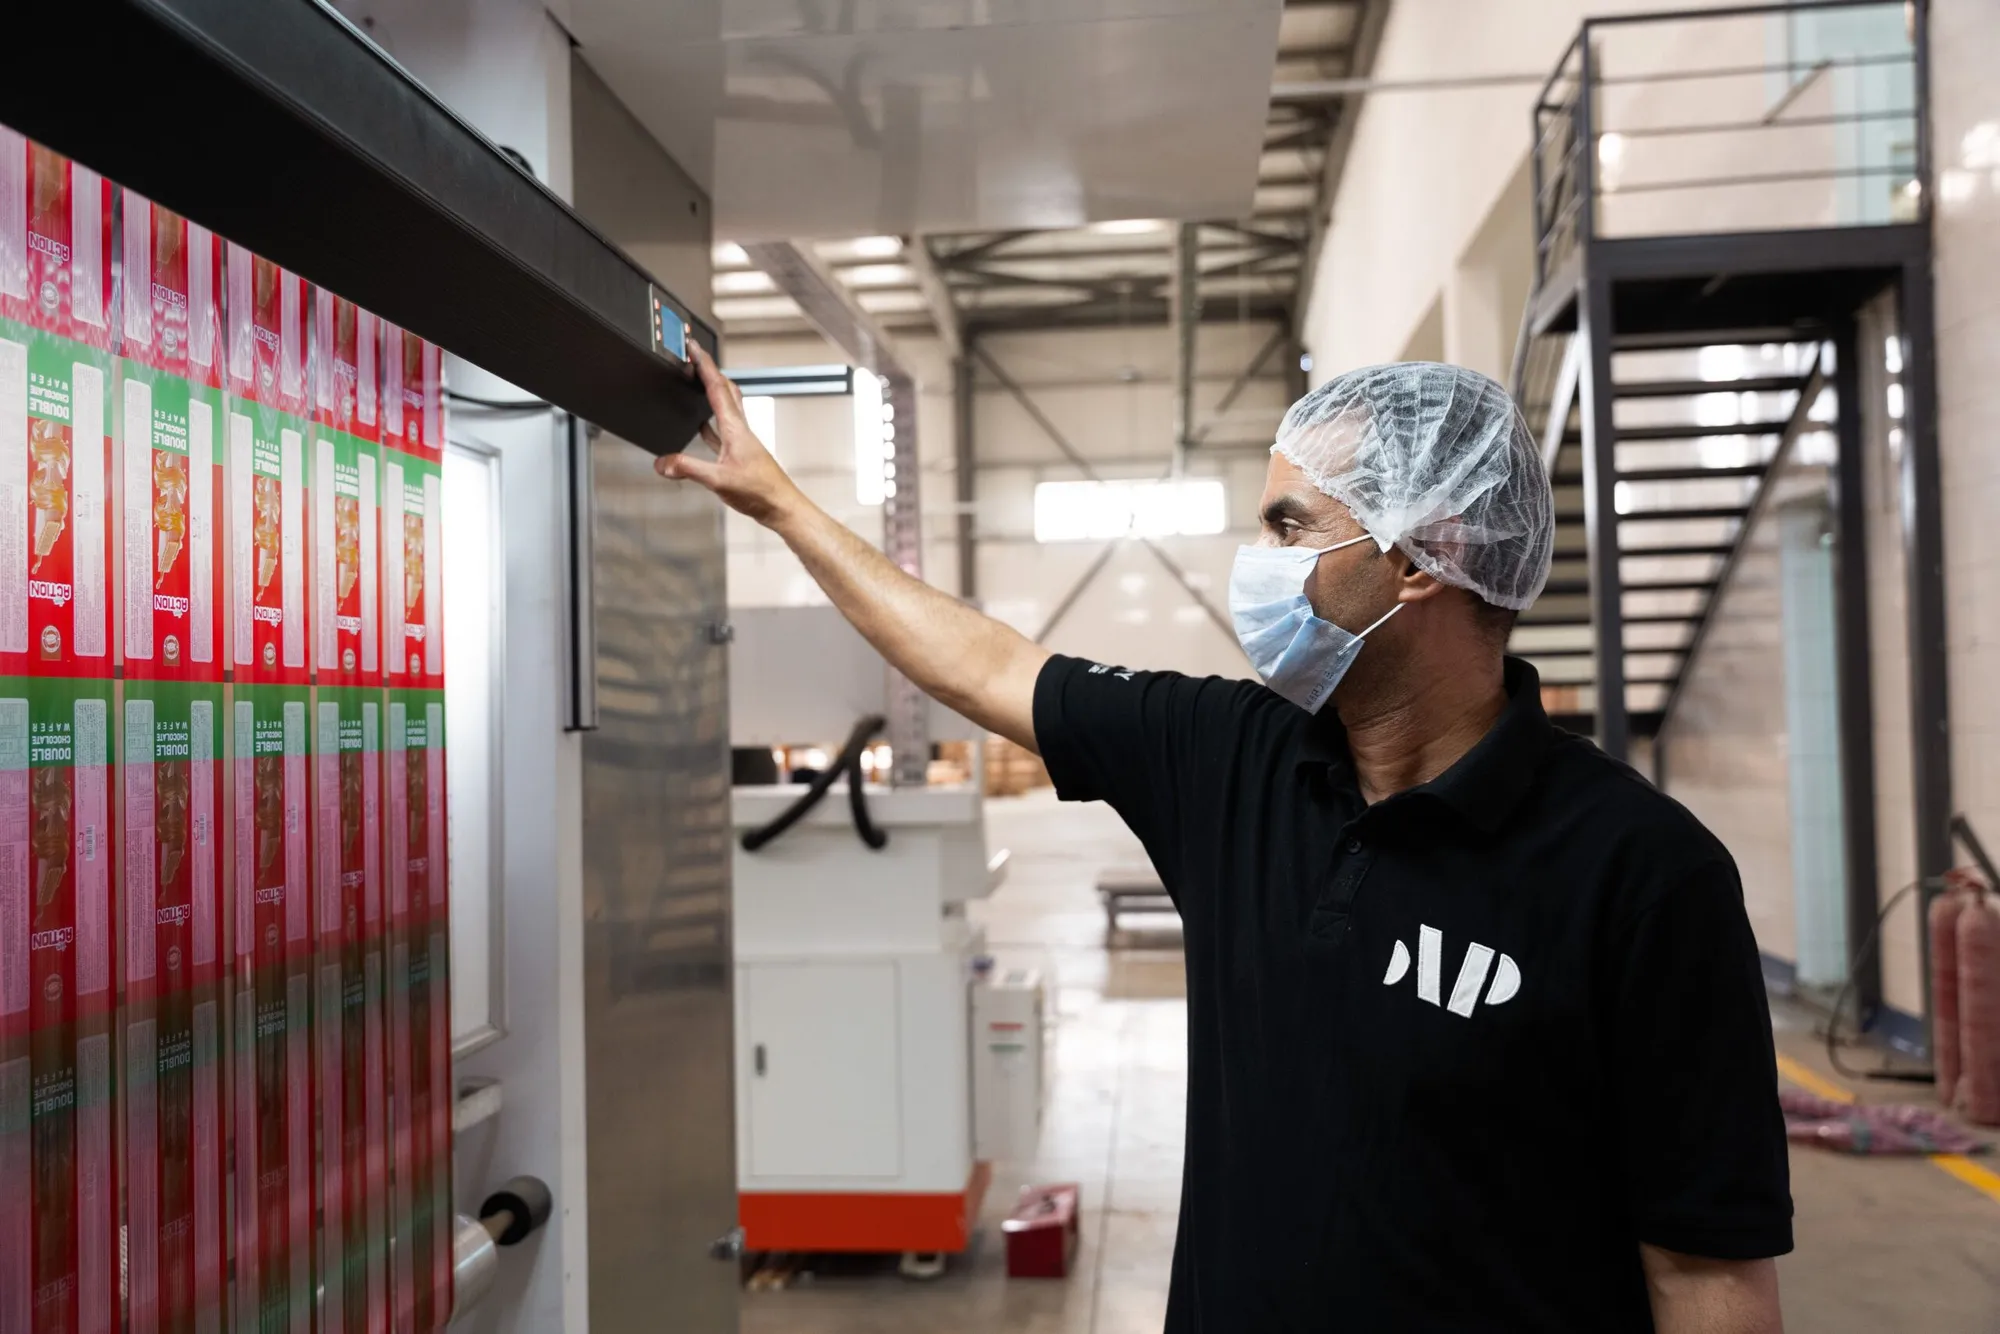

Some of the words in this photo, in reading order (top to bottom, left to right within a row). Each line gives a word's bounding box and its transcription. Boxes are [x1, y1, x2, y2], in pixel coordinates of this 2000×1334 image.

[28, 232, 69, 261] ACTION
[153, 283, 186, 308] ACTION
[31, 373, 68, 390] WAFER
[29, 397, 69, 419] DOUBLE
[154, 410, 186, 425] WAFER
[153, 431, 187, 450] DOUBLE
[29, 580, 71, 601] ACTION
[154, 595, 188, 613] ACTION
[255, 606, 281, 622] ACTION
[32, 723, 70, 731] WAFER
[157, 722, 188, 730] WAFER
[32, 735, 70, 745] CHOCOLATE
[157, 733, 188, 742] CHOCOLATE
[31, 748, 71, 761] DOUBLE
[156, 744, 188, 756] DOUBLE
[256, 741, 282, 752] DOUBLE
[256, 886, 284, 903] ACTION
[157, 904, 190, 925] ACTION
[32, 927, 73, 950] ACTION
[159, 1029, 190, 1046] WAFER
[159, 1052, 190, 1072] DOUBLE
[35, 1067, 73, 1086] WAFER
[34, 1092, 73, 1116] DOUBLE
